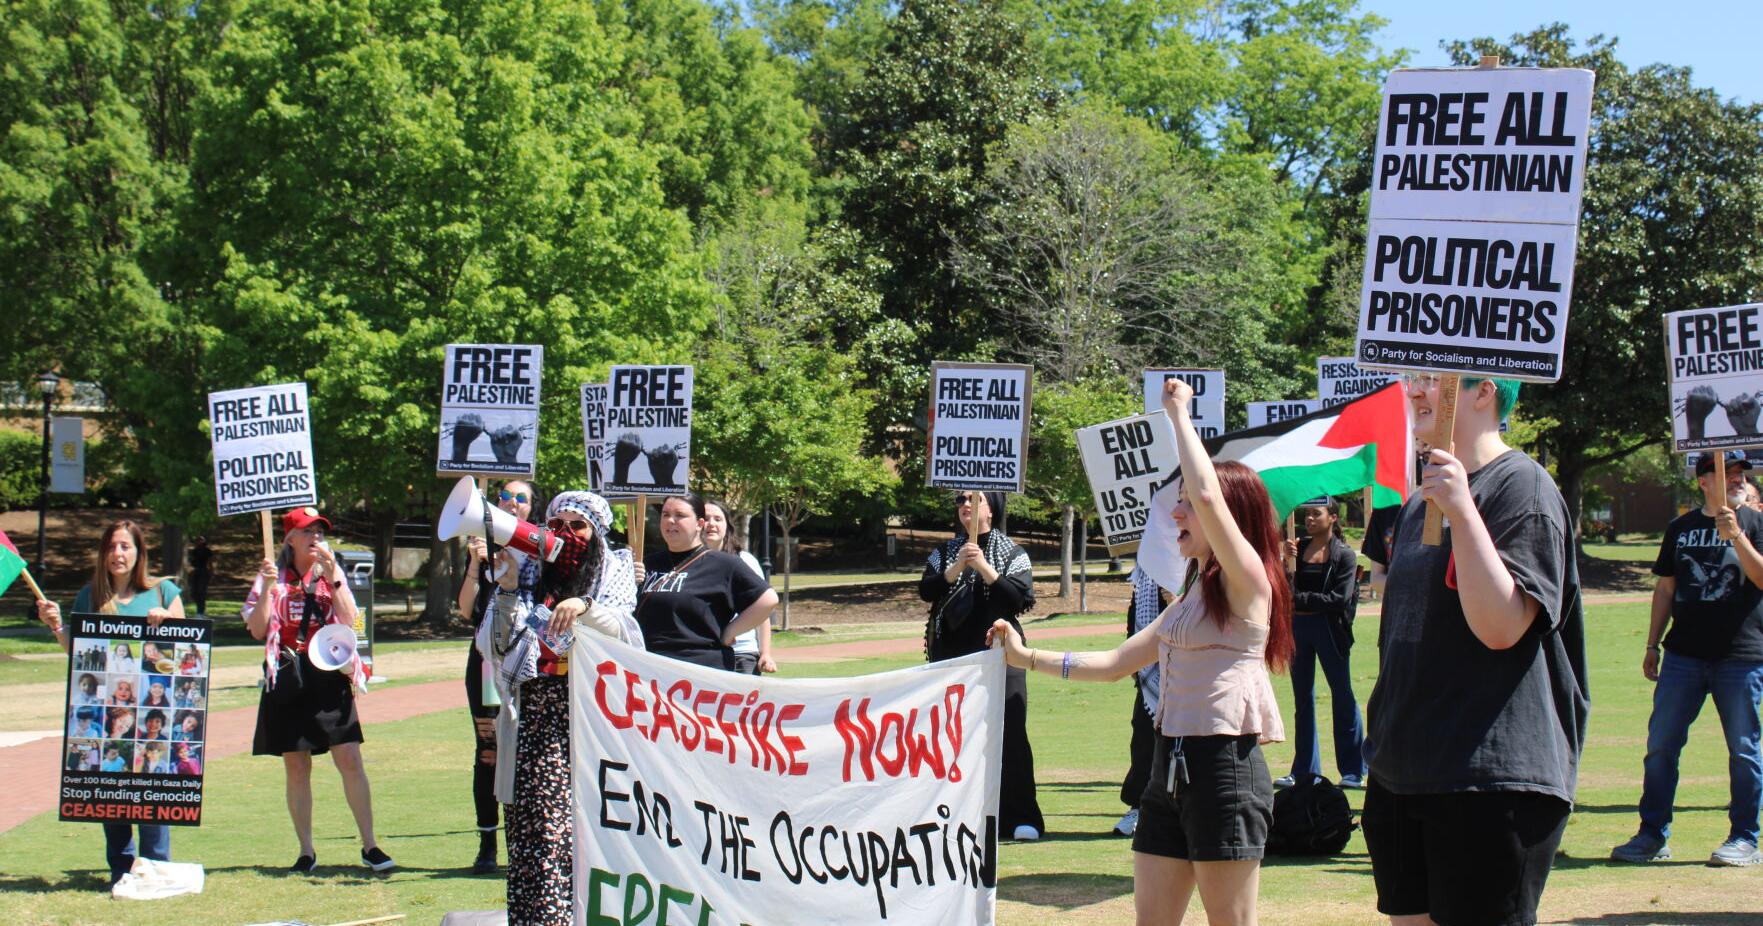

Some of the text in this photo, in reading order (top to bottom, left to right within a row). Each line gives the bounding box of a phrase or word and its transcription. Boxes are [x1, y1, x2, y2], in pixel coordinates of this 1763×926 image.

[1385, 92, 1576, 146] FREE ALL
[1380, 153, 1573, 192] PALESTINIAN
[1373, 235, 1562, 292] POLITICAL
[1367, 290, 1557, 344] PRISONERS
[1678, 308, 1761, 355] FREE
[453, 348, 532, 385] FREE
[1382, 348, 1406, 361] Party
[1410, 350, 1423, 361] for
[1426, 351, 1473, 364] Socialism
[1476, 356, 1496, 366] and
[1499, 357, 1552, 371] Liberation
[447, 385, 535, 405] PALESTINE
[614, 368, 685, 407] FREE
[939, 378, 1020, 401] FREE ALL
[213, 393, 303, 423] FREE ALL
[608, 408, 688, 428] PALESTINE
[938, 403, 1020, 420] PALESTINIAN
[215, 417, 304, 442] PALESTINIAN
[1100, 420, 1154, 454] END
[936, 436, 1016, 458] POLITICAL
[219, 451, 308, 480] POLITICAL
[935, 459, 1015, 478] PRISONERS
[1114, 449, 1159, 480] ALL
[221, 474, 309, 500] PRISONERS
[1101, 486, 1145, 513] U.S.
[1105, 514, 1127, 532] TO
[82, 620, 96, 633] In
[100, 620, 142, 638] loving
[63, 788, 201, 802] Stop funding Genocide
[83, 776, 99, 784] 100
[100, 776, 117, 785] Kids
[118, 778, 130, 787] get
[132, 778, 152, 786] killed
[154, 778, 161, 787] in
[162, 779, 181, 787] Gaza
[182, 780, 201, 789] Daily
[61, 803, 200, 821] CEASEFIRE NOW
[694, 800, 761, 881] THE
